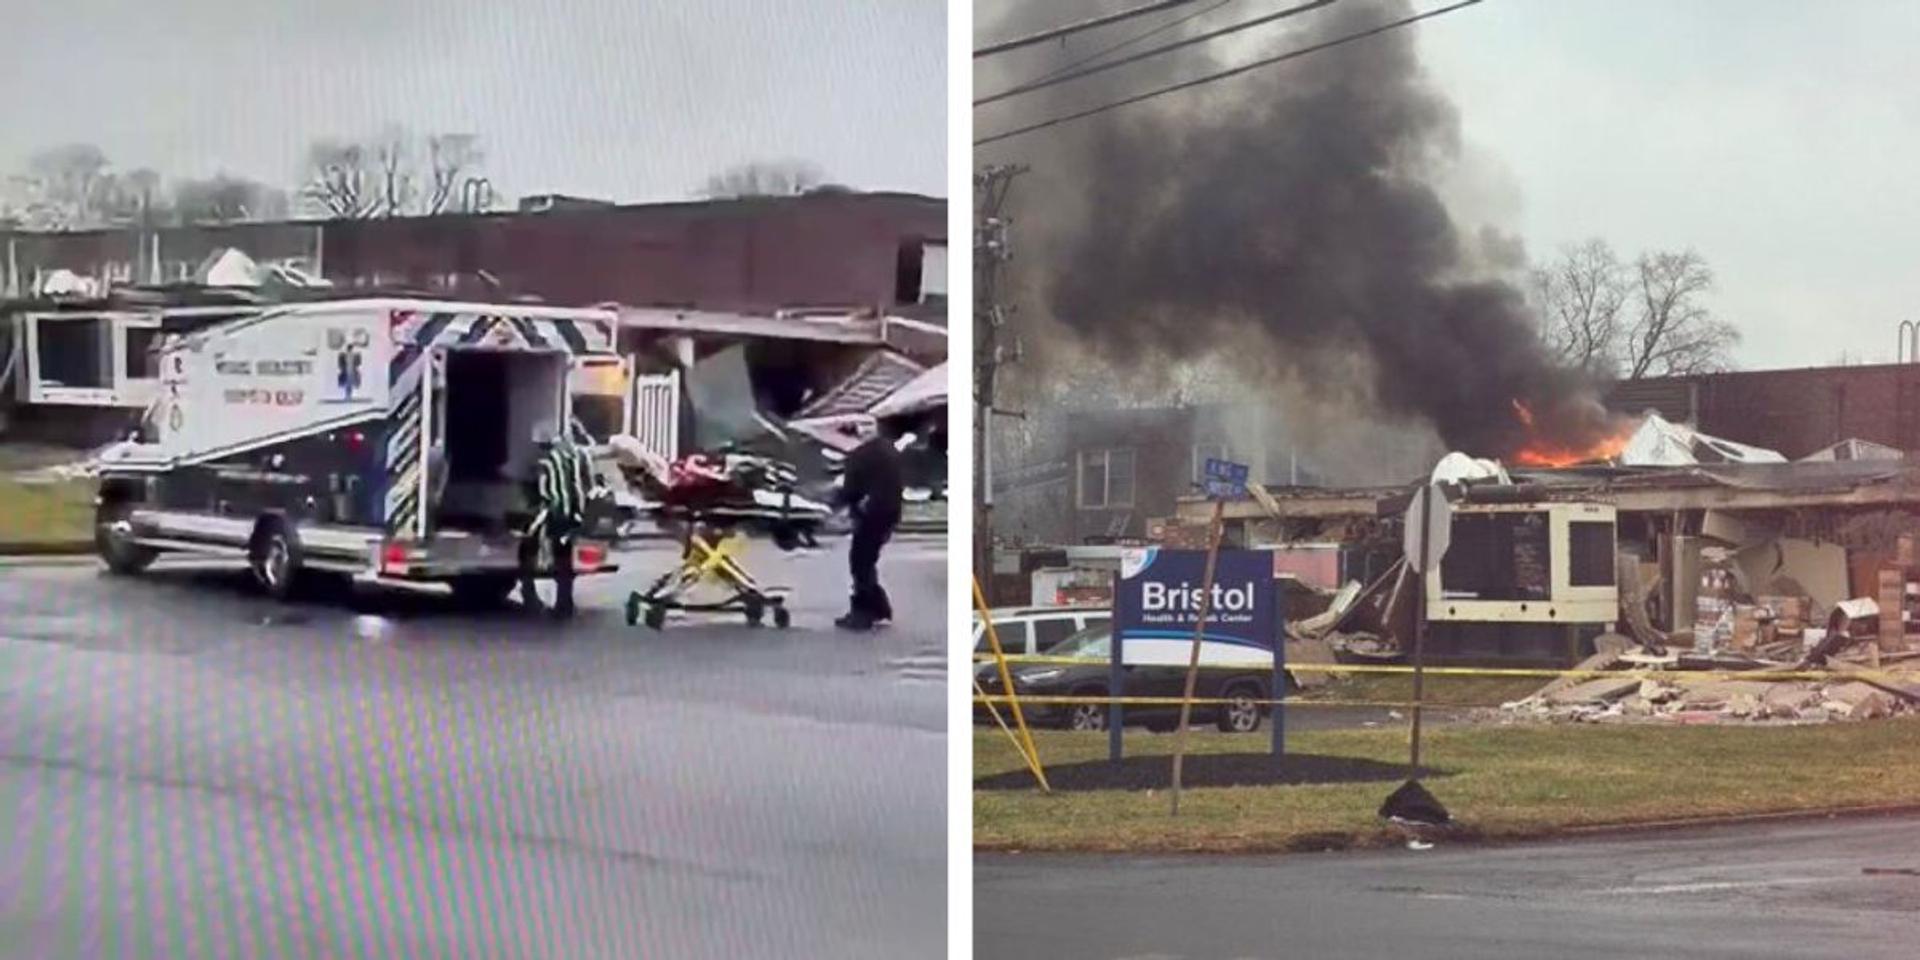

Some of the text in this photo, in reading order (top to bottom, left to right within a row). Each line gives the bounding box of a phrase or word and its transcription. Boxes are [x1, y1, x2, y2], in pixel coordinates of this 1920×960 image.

[1142, 581, 1254, 611] Bristol
[1142, 613, 1253, 623] Health & Reab Center
